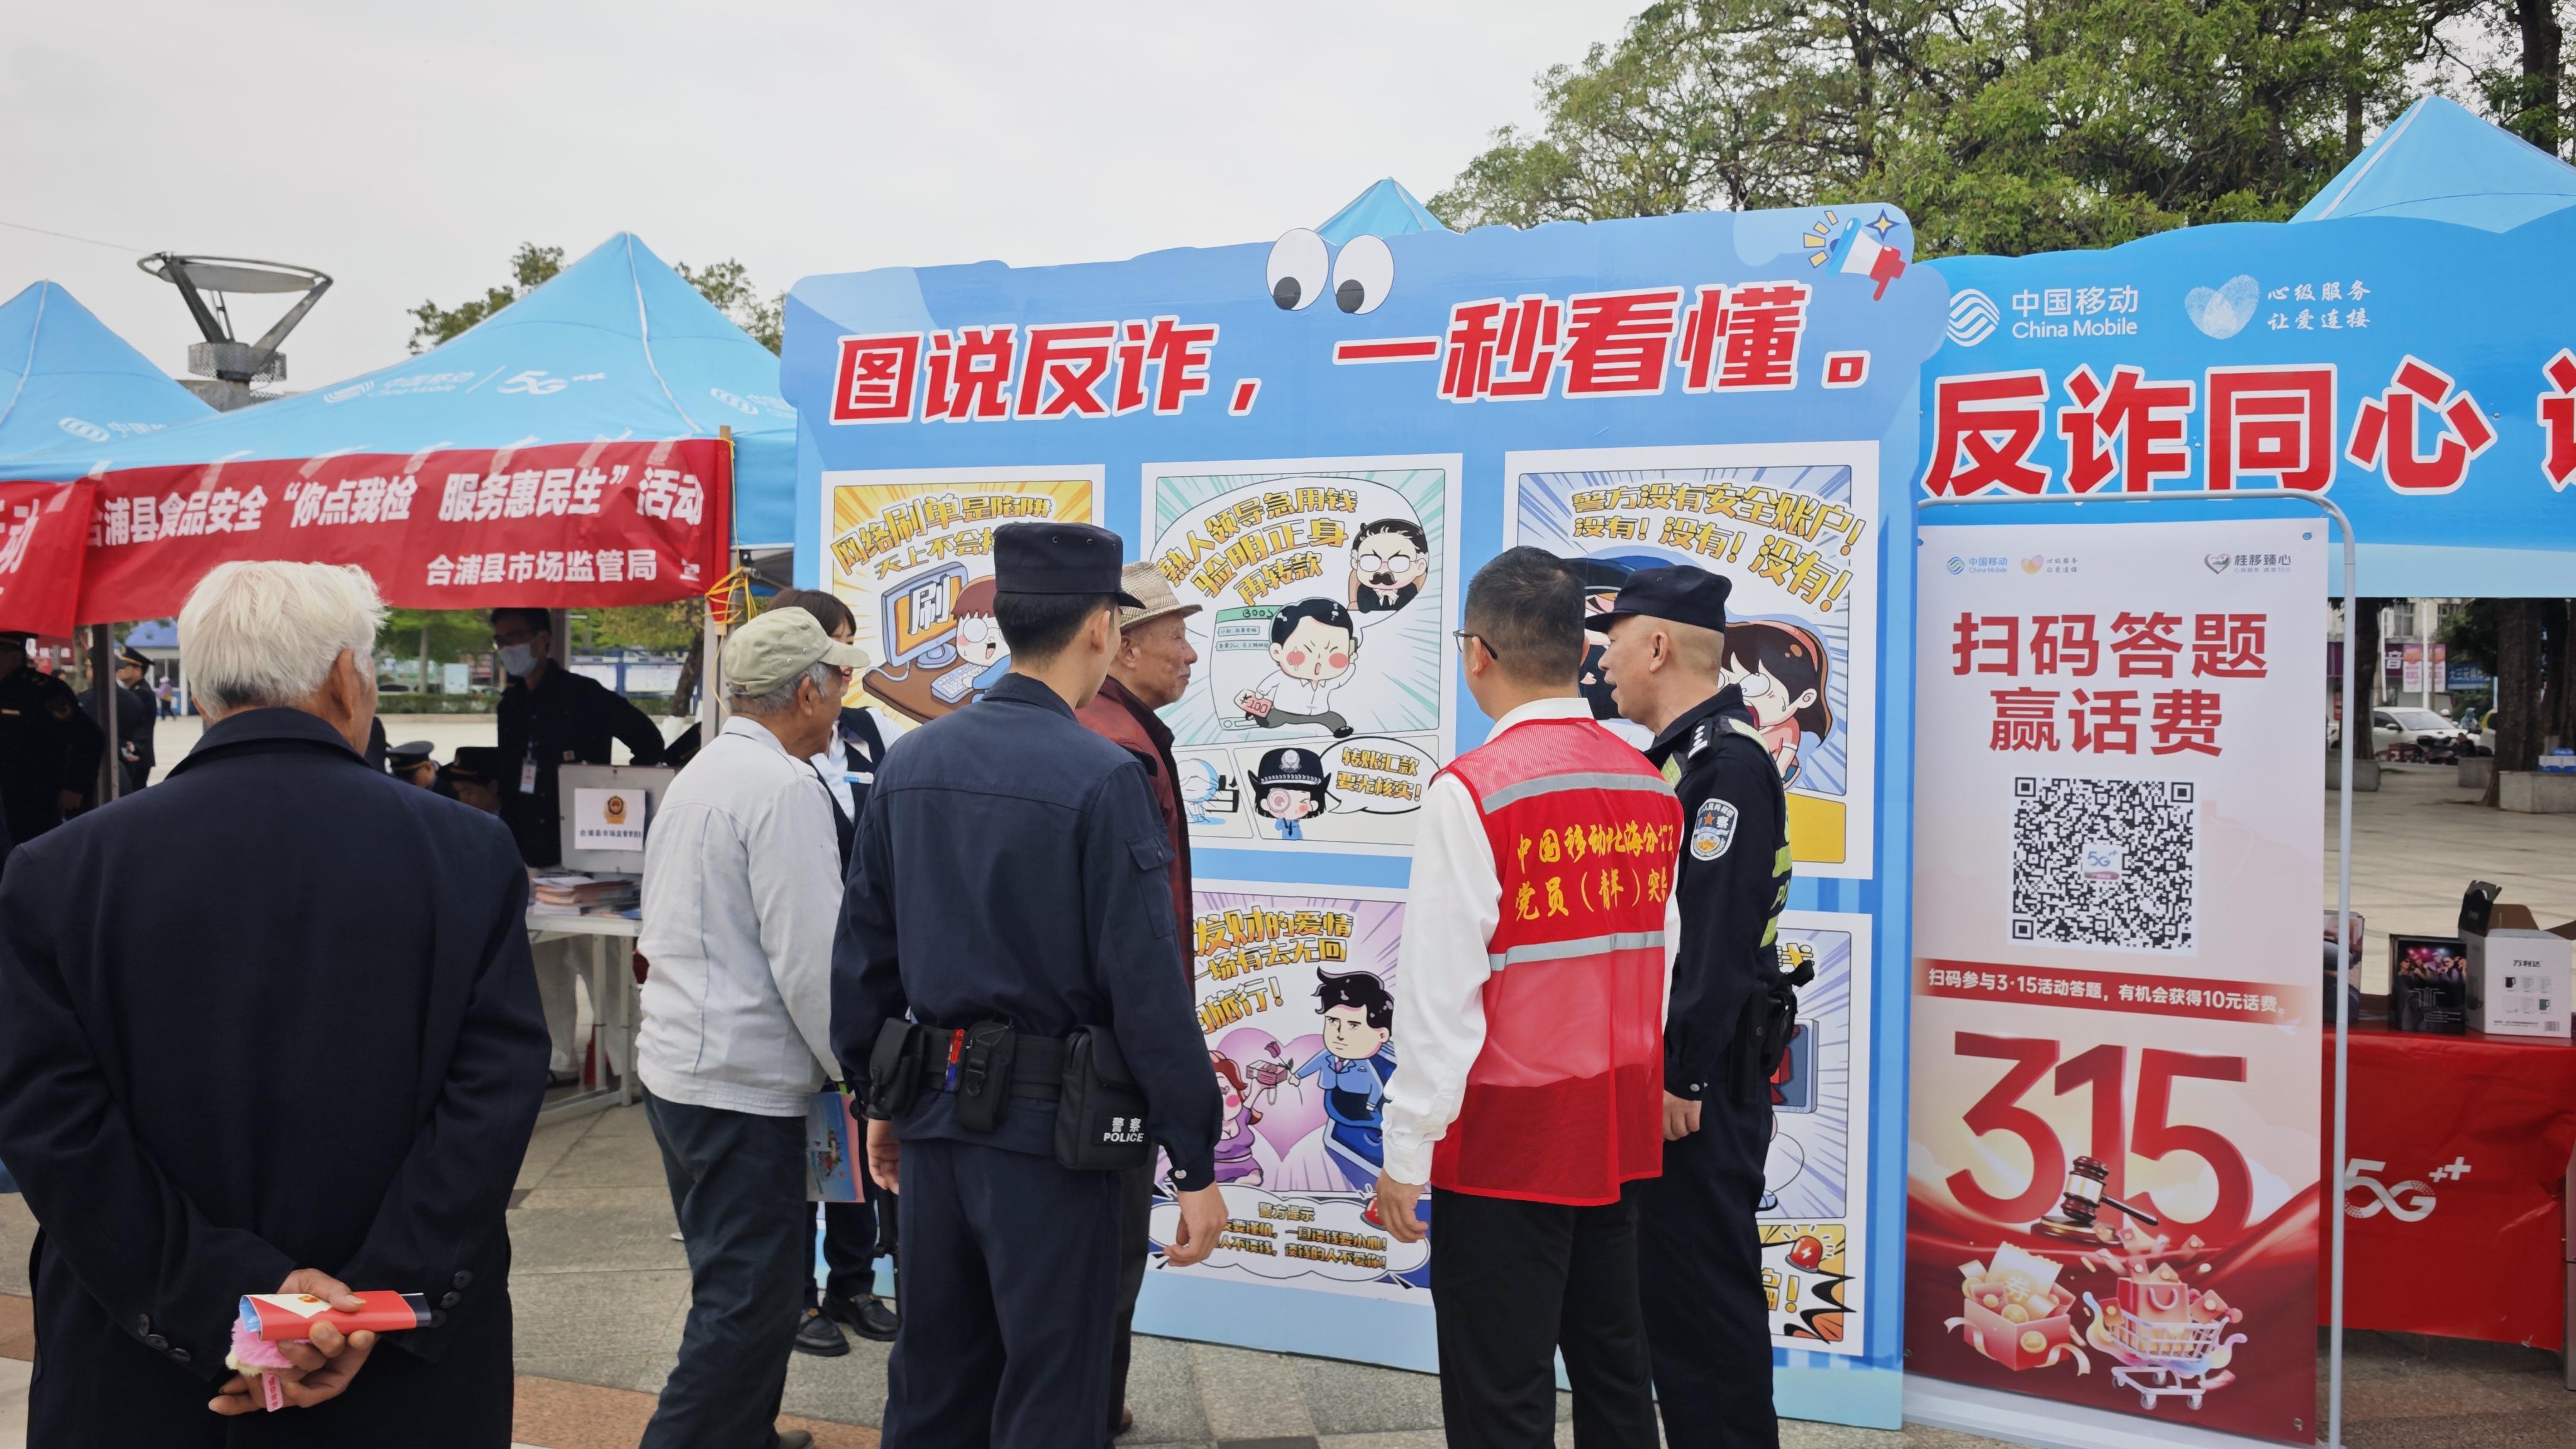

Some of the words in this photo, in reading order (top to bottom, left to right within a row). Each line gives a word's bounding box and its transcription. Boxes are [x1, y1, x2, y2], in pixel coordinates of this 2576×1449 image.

[2013, 285, 2138, 316] 中国移动
[2267, 280, 2371, 302] 心级服务
[2012, 320, 2068, 339] China
[2074, 318, 2138, 337] Mobile
[2267, 308, 2371, 330] 让爱连接
[1923, 357, 2495, 496] 反诈同心
[636, 466, 704, 526] 活动
[831, 493, 1052, 575] 网络刷单是陷阱
[1157, 487, 1358, 587] 熟人领导急用钱
[1572, 482, 1866, 556] 警方没有安全账户！
[426, 549, 657, 586] 合浦县市场监管局
[1191, 518, 1349, 598] 验明正身
[1969, 557, 2007, 566] 中国移动
[2235, 554, 2292, 566] 桂移臻心
[1233, 552, 1323, 606] 再转款
[909, 574, 951, 635] 刷
[1952, 611, 2268, 679] 扫码答题
[1989, 686, 2223, 757] 赢话费
[1342, 747, 1420, 777] 转账汇款
[1336, 771, 1423, 802] 要先核实！
[1103, 1133, 1144, 1142] POLICE
[1112, 1117, 1141, 1132] 警察
[1946, 1031, 2253, 1240] 315
[1258, 1202, 1315, 1221] 警方提示
